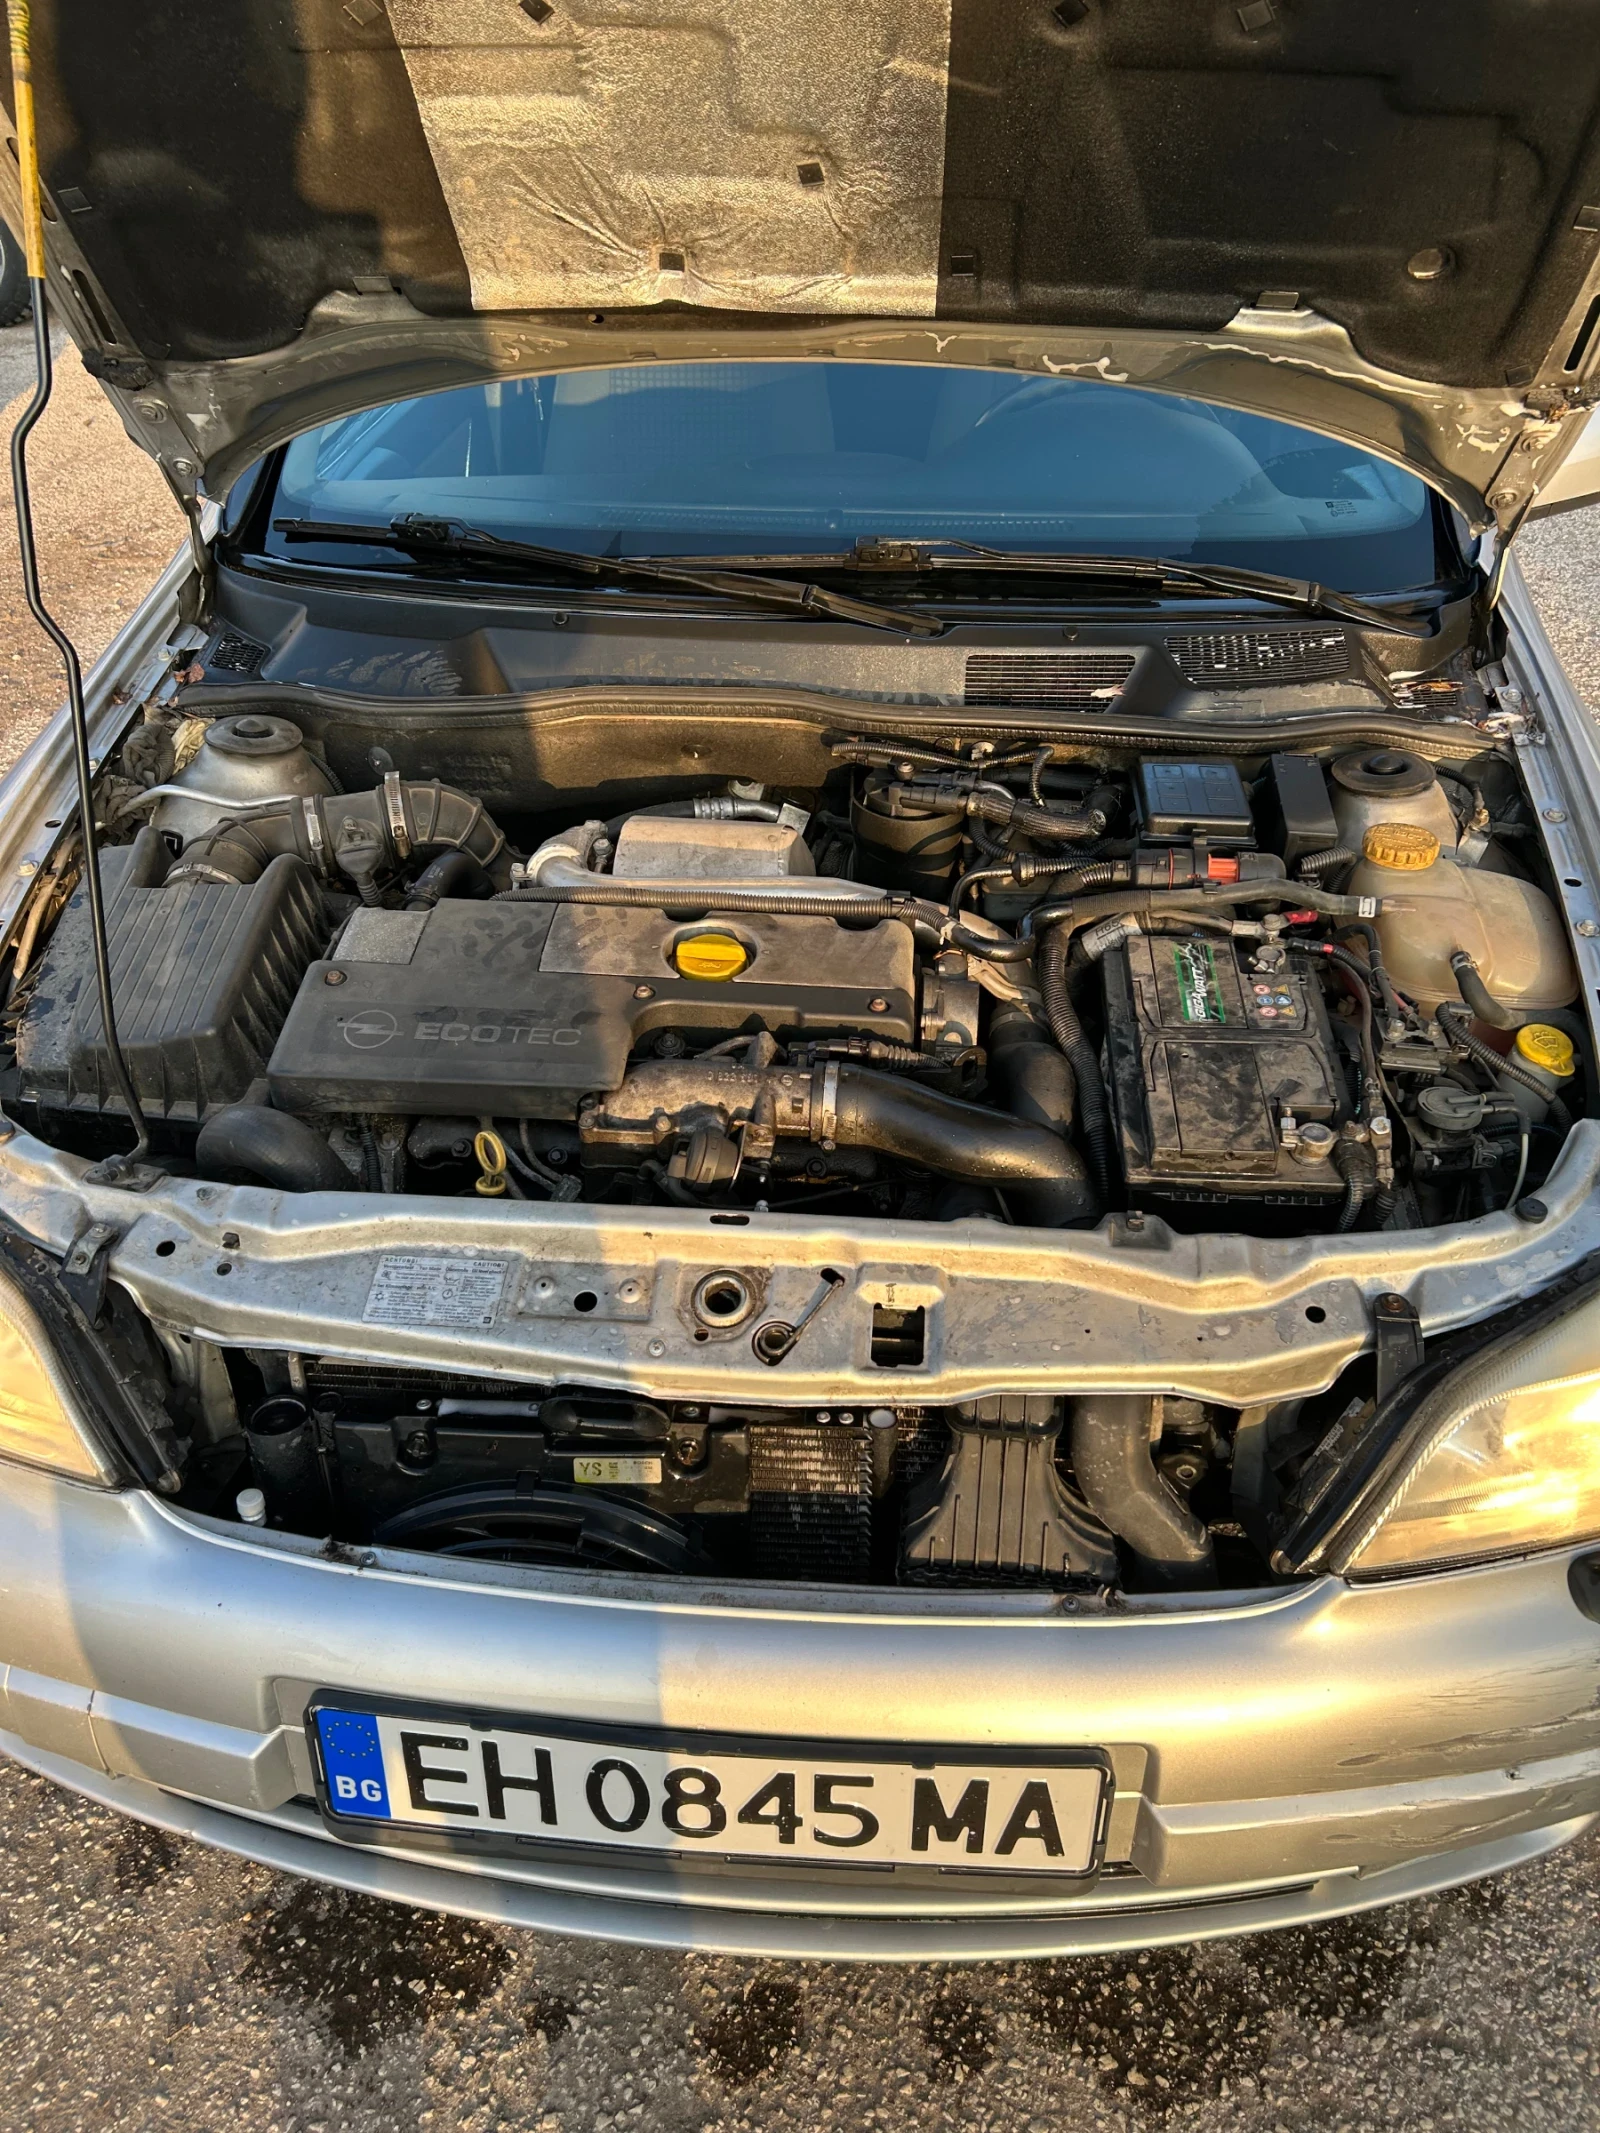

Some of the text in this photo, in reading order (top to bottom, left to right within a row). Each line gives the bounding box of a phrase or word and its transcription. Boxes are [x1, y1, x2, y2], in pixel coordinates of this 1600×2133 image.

[1191, 966, 1208, 1018] GIGAWATT
[414, 1022, 582, 1046] ECOTEC
[579, 1462, 602, 1476] YS
[335, 1775, 382, 1802] BG
